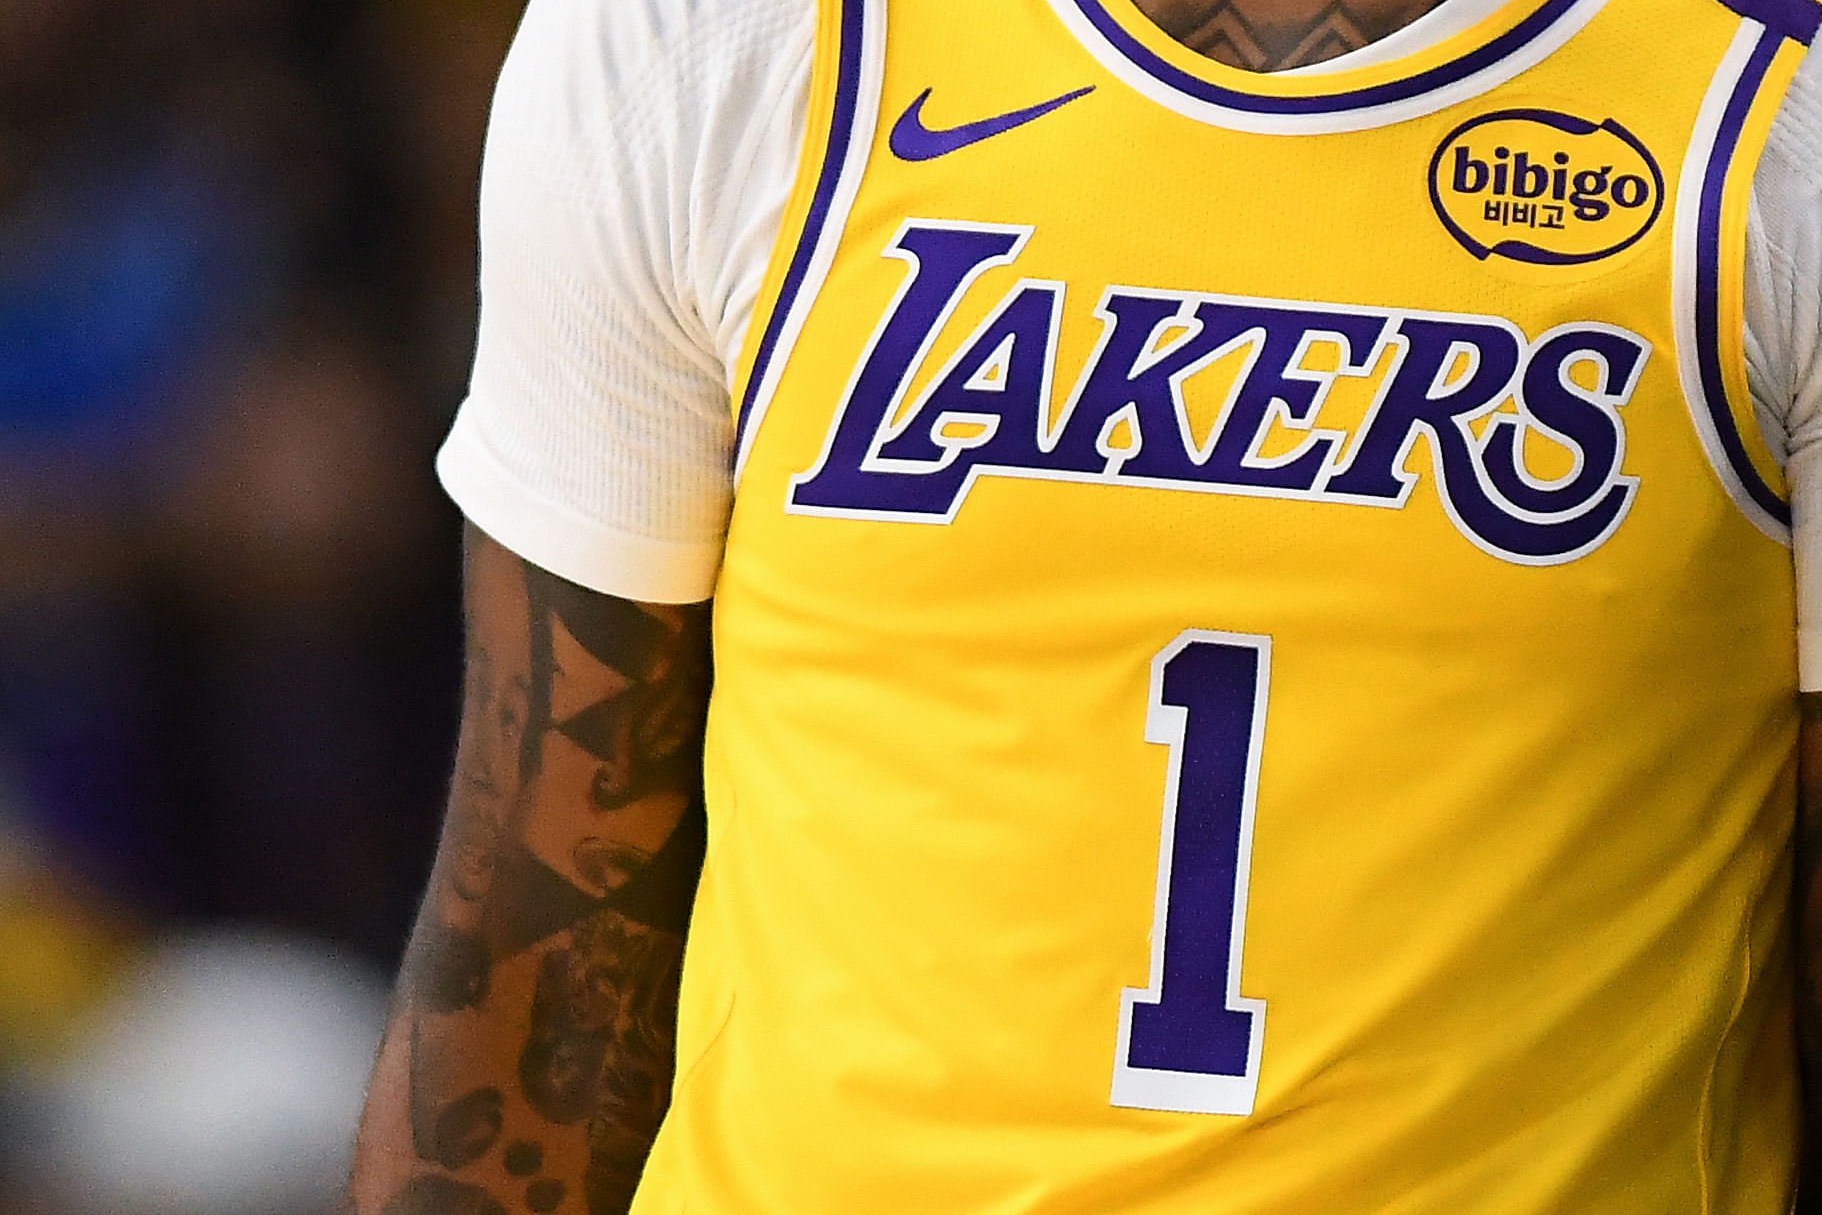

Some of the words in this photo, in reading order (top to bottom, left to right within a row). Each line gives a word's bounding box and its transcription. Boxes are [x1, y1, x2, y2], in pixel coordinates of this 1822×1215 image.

[1452, 145, 1649, 222] bibigo
[1484, 199, 1566, 230] 비비고
[787, 218, 1651, 566] LAKERS
[1110, 627, 1273, 1116] 1
